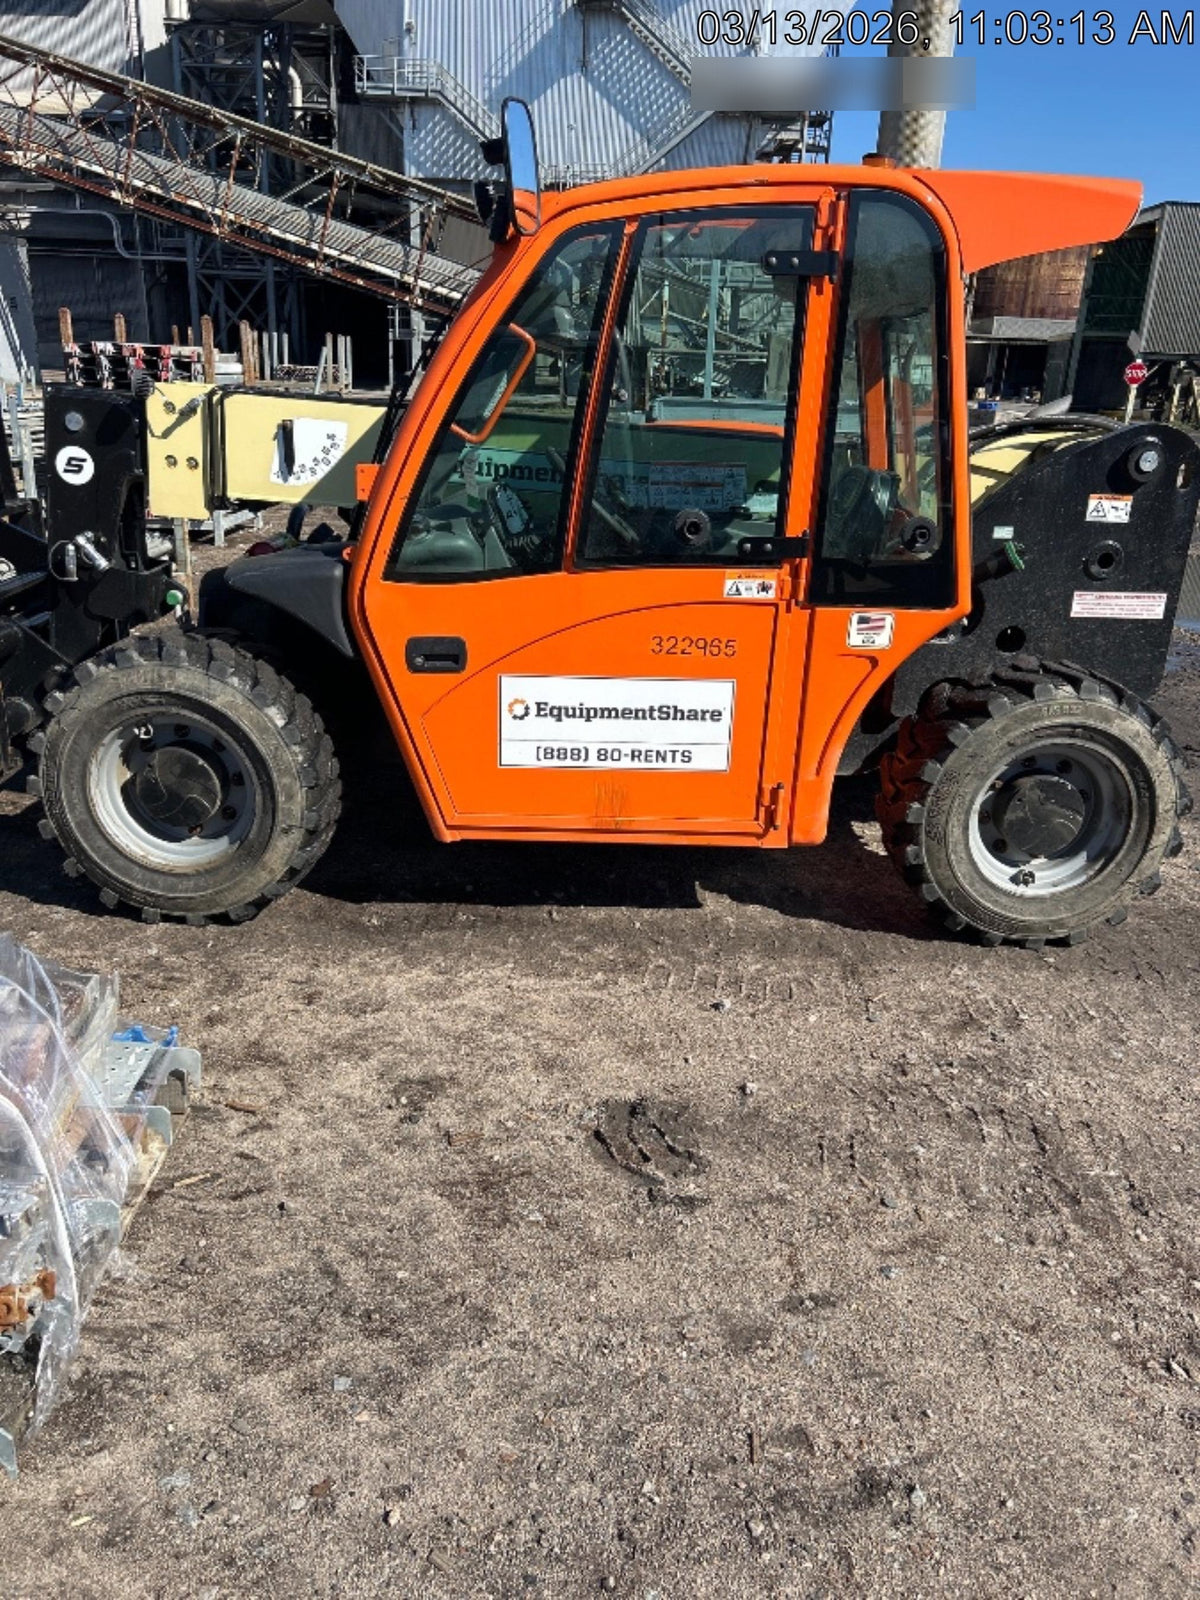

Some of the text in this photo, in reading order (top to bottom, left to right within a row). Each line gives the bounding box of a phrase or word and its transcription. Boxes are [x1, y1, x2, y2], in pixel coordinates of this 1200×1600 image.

[650, 635, 737, 657] 322965
[534, 701, 723, 722] EquipmentShare
[535, 745, 693, 764] (888) 80-RENTS
